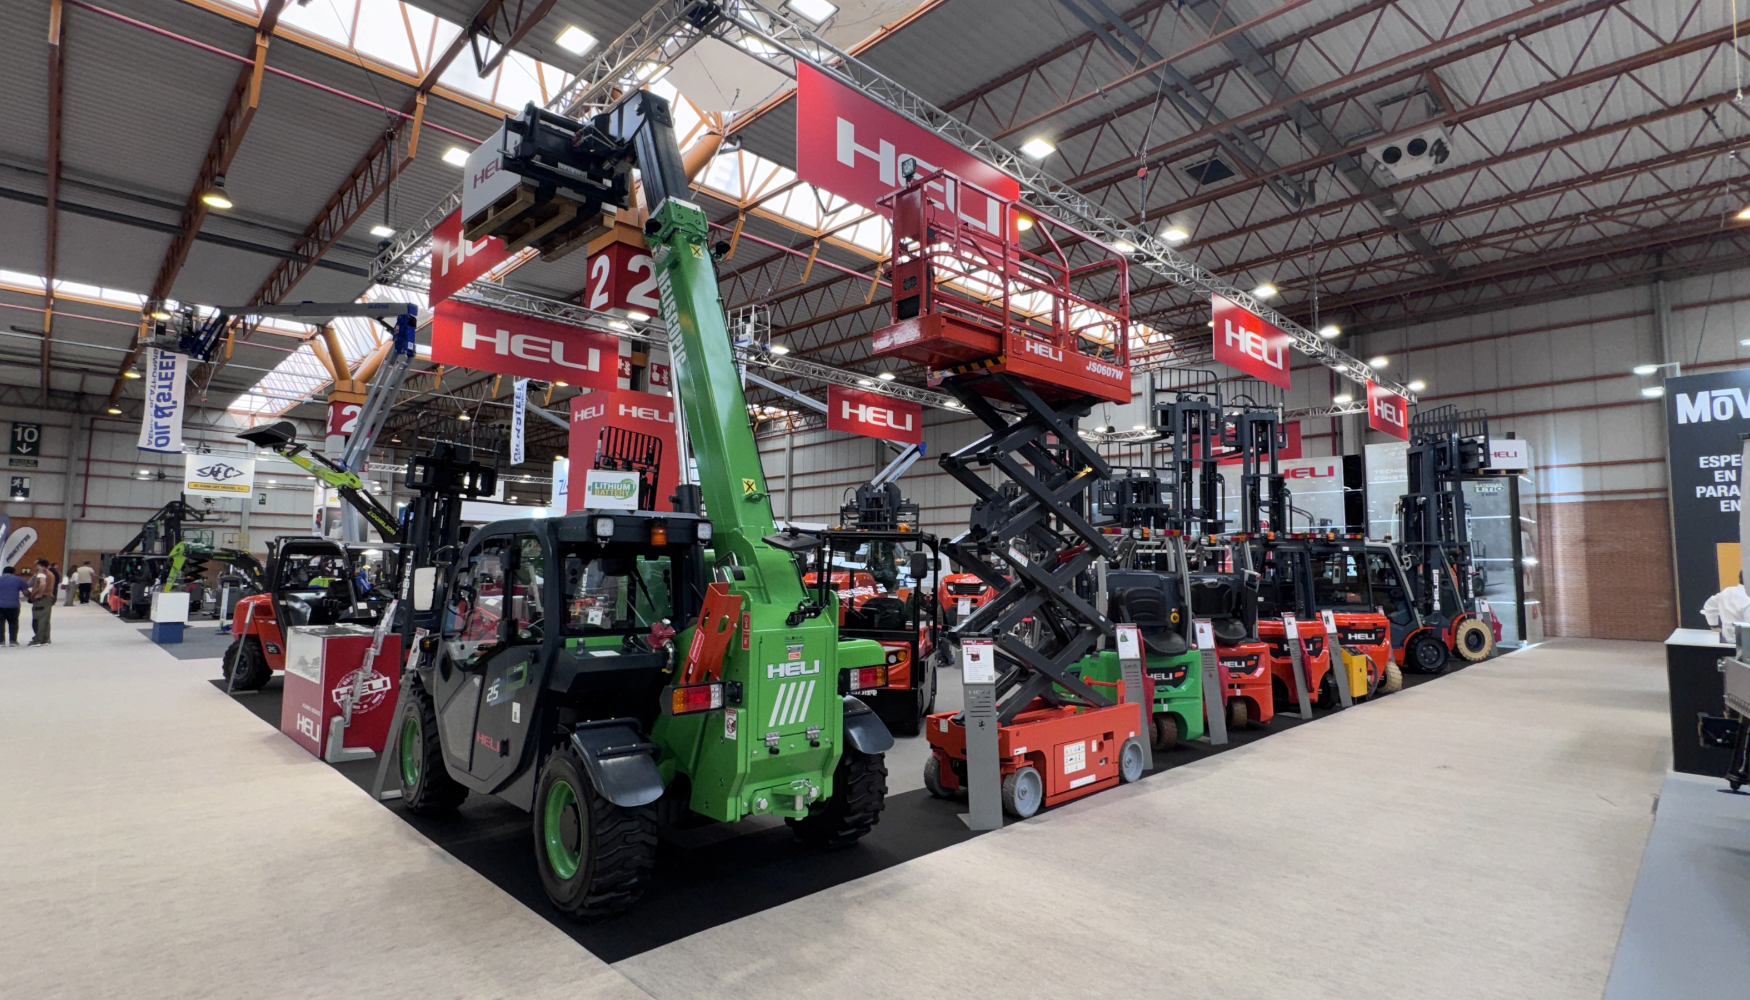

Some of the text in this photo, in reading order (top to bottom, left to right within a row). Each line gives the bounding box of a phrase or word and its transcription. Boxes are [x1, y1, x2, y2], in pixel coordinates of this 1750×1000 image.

[473, 157, 502, 190] HEL
[837, 116, 1000, 238] HELI
[591, 254, 610, 311] 2
[626, 254, 660, 310] 2
[657, 267, 687, 367] HELISCOPIC
[461, 321, 601, 373] HELI
[1025, 340, 1063, 363] HELI
[1225, 318, 1283, 371] HELI
[1086, 360, 1124, 381] JS0607W
[340, 404, 362, 433] 2
[574, 403, 605, 423] HELI
[618, 403, 674, 424] HELI
[842, 400, 913, 432] HELI
[1374, 397, 1405, 428] HELI
[13, 426, 39, 443] 10
[1699, 454, 1743, 469] ESPE
[1279, 465, 1335, 480] HELI
[1714, 469, 1737, 483] EN
[594, 481, 631, 491] LITHIUM
[594, 489, 630, 497] BATTERY
[1695, 484, 1741, 498] PARA
[1720, 499, 1742, 513] EN
[366, 509, 397, 536] ZOOMLION
[767, 659, 821, 680] HELI
[1146, 672, 1173, 680] HELI
[486, 684, 500, 703] 25
[296, 712, 321, 742] HELI
[475, 732, 501, 753] HELI
